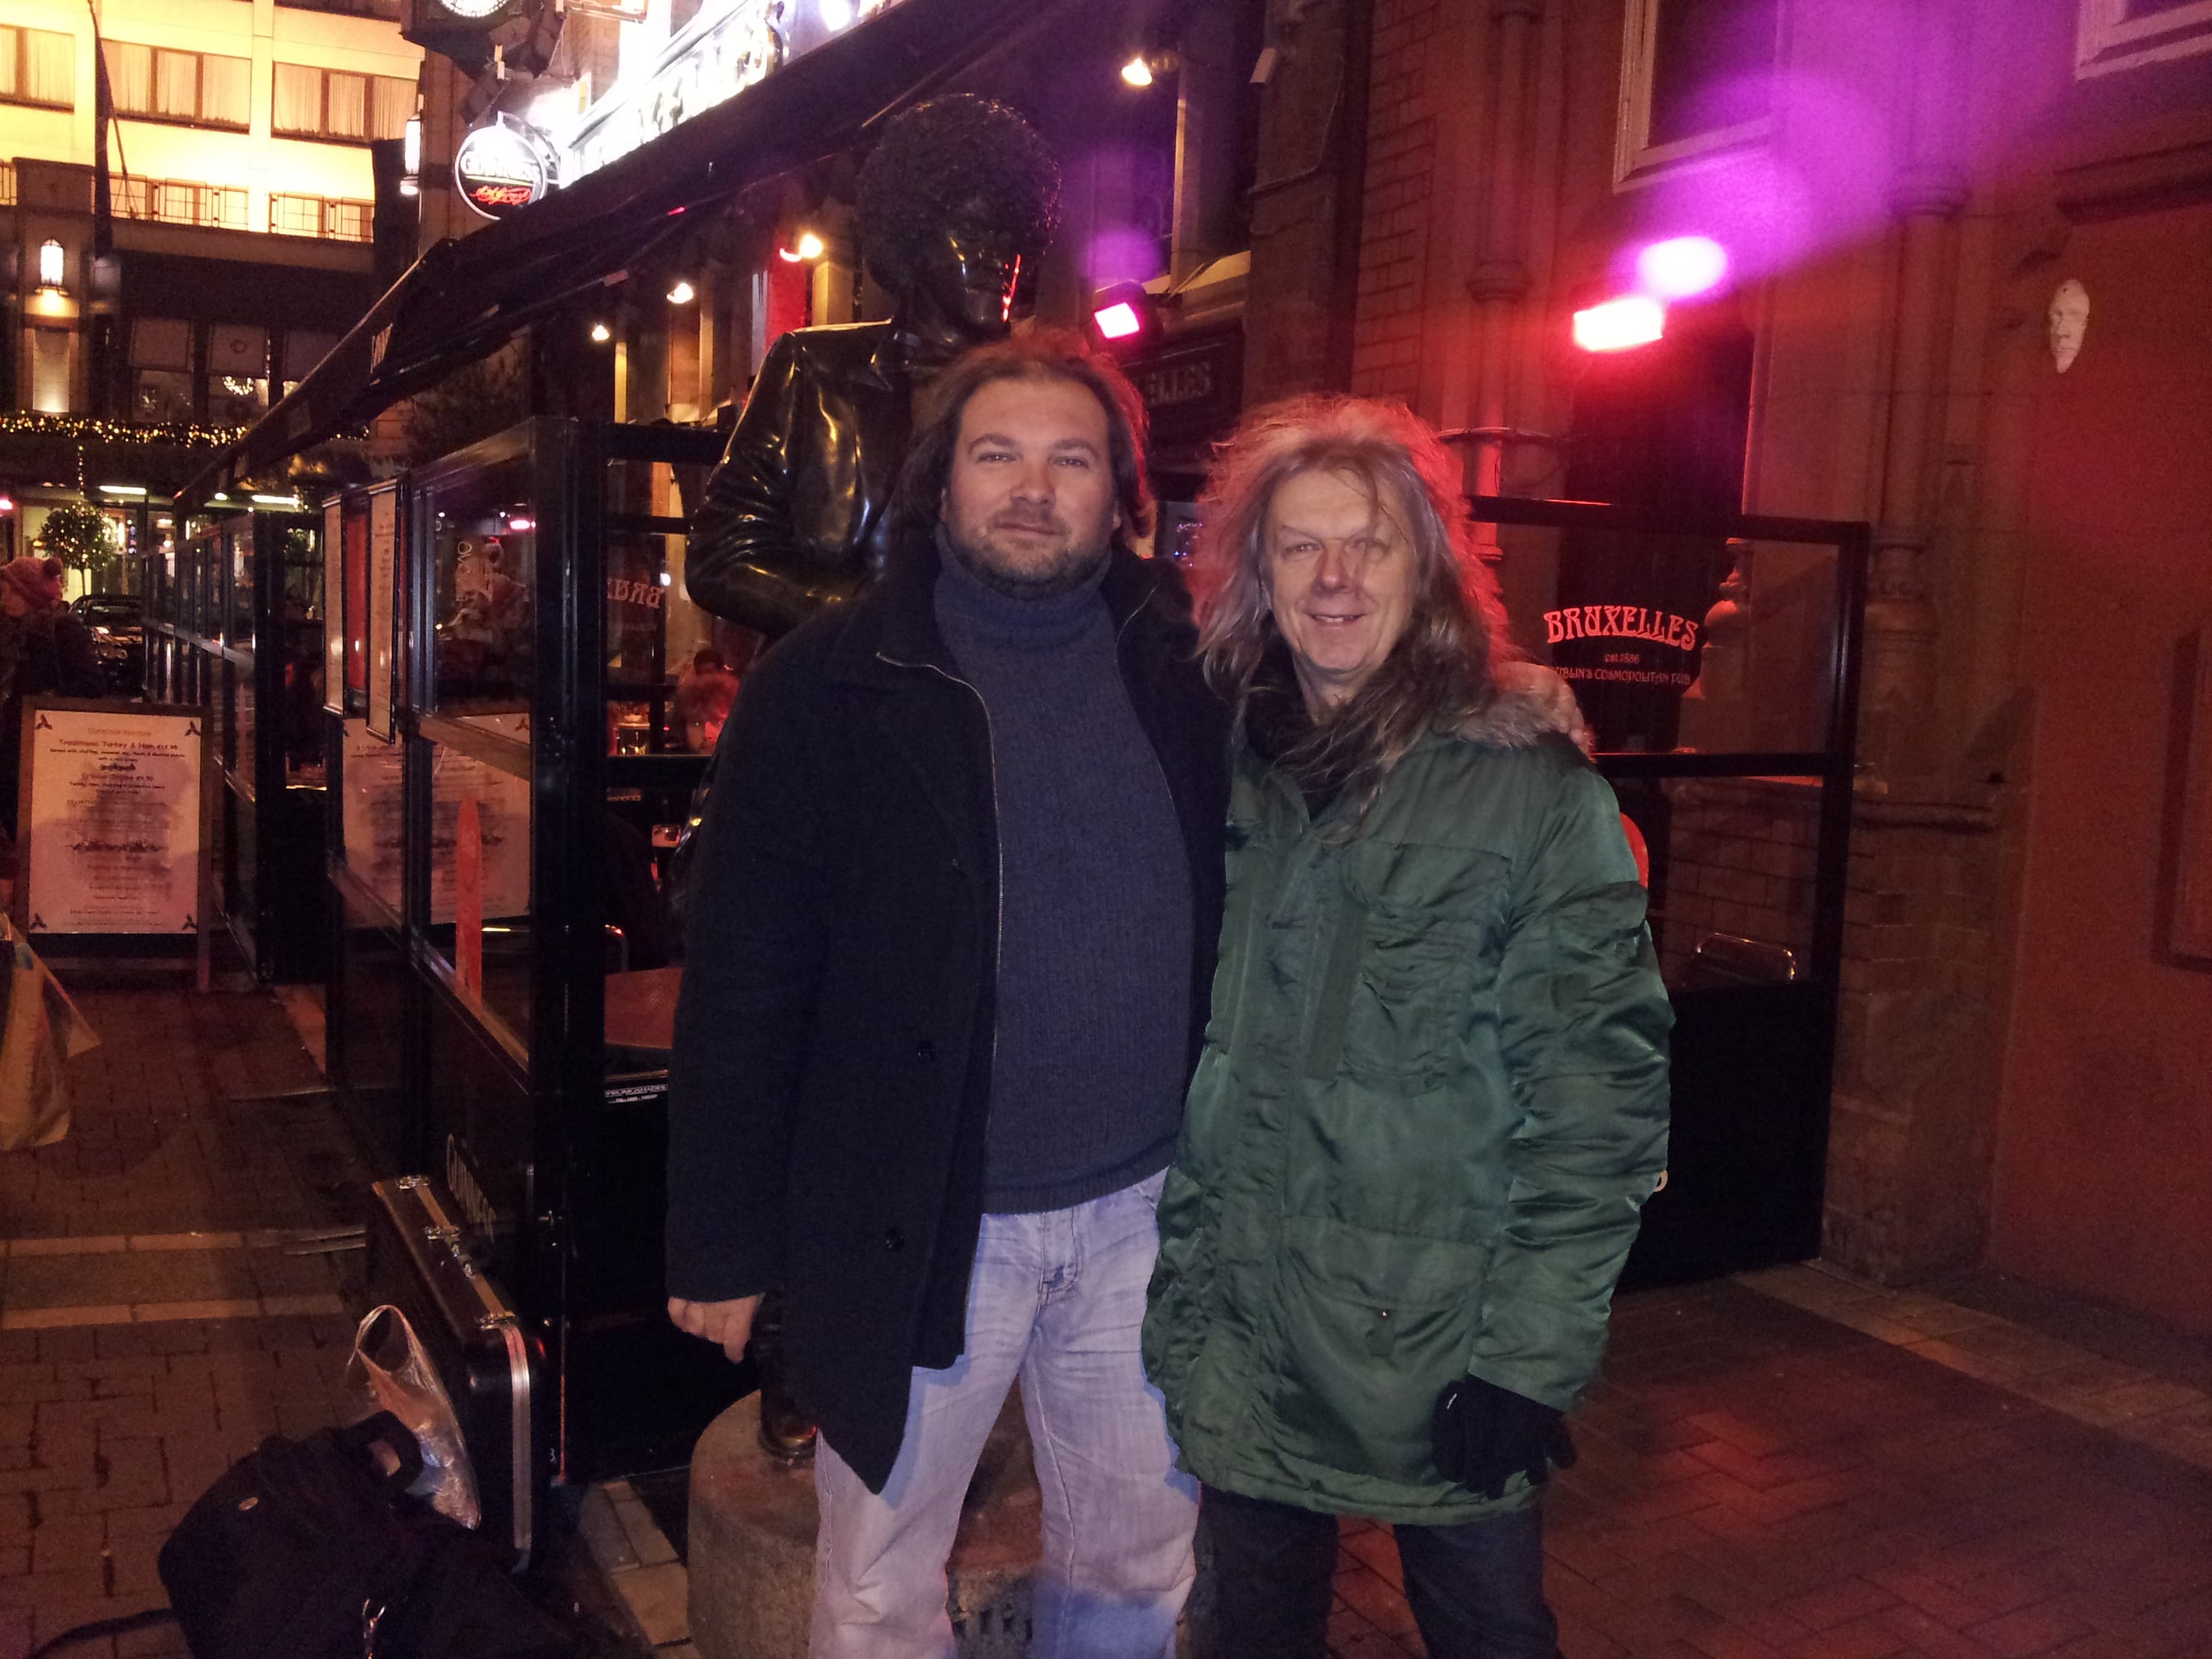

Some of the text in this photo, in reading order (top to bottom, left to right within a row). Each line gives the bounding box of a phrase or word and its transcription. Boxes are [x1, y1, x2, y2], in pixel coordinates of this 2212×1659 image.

[1145, 361, 1212, 407] ELLES
[1543, 605, 1698, 651] BRUXELLES
[1595, 668, 1669, 684] COSMOPOLITAN
